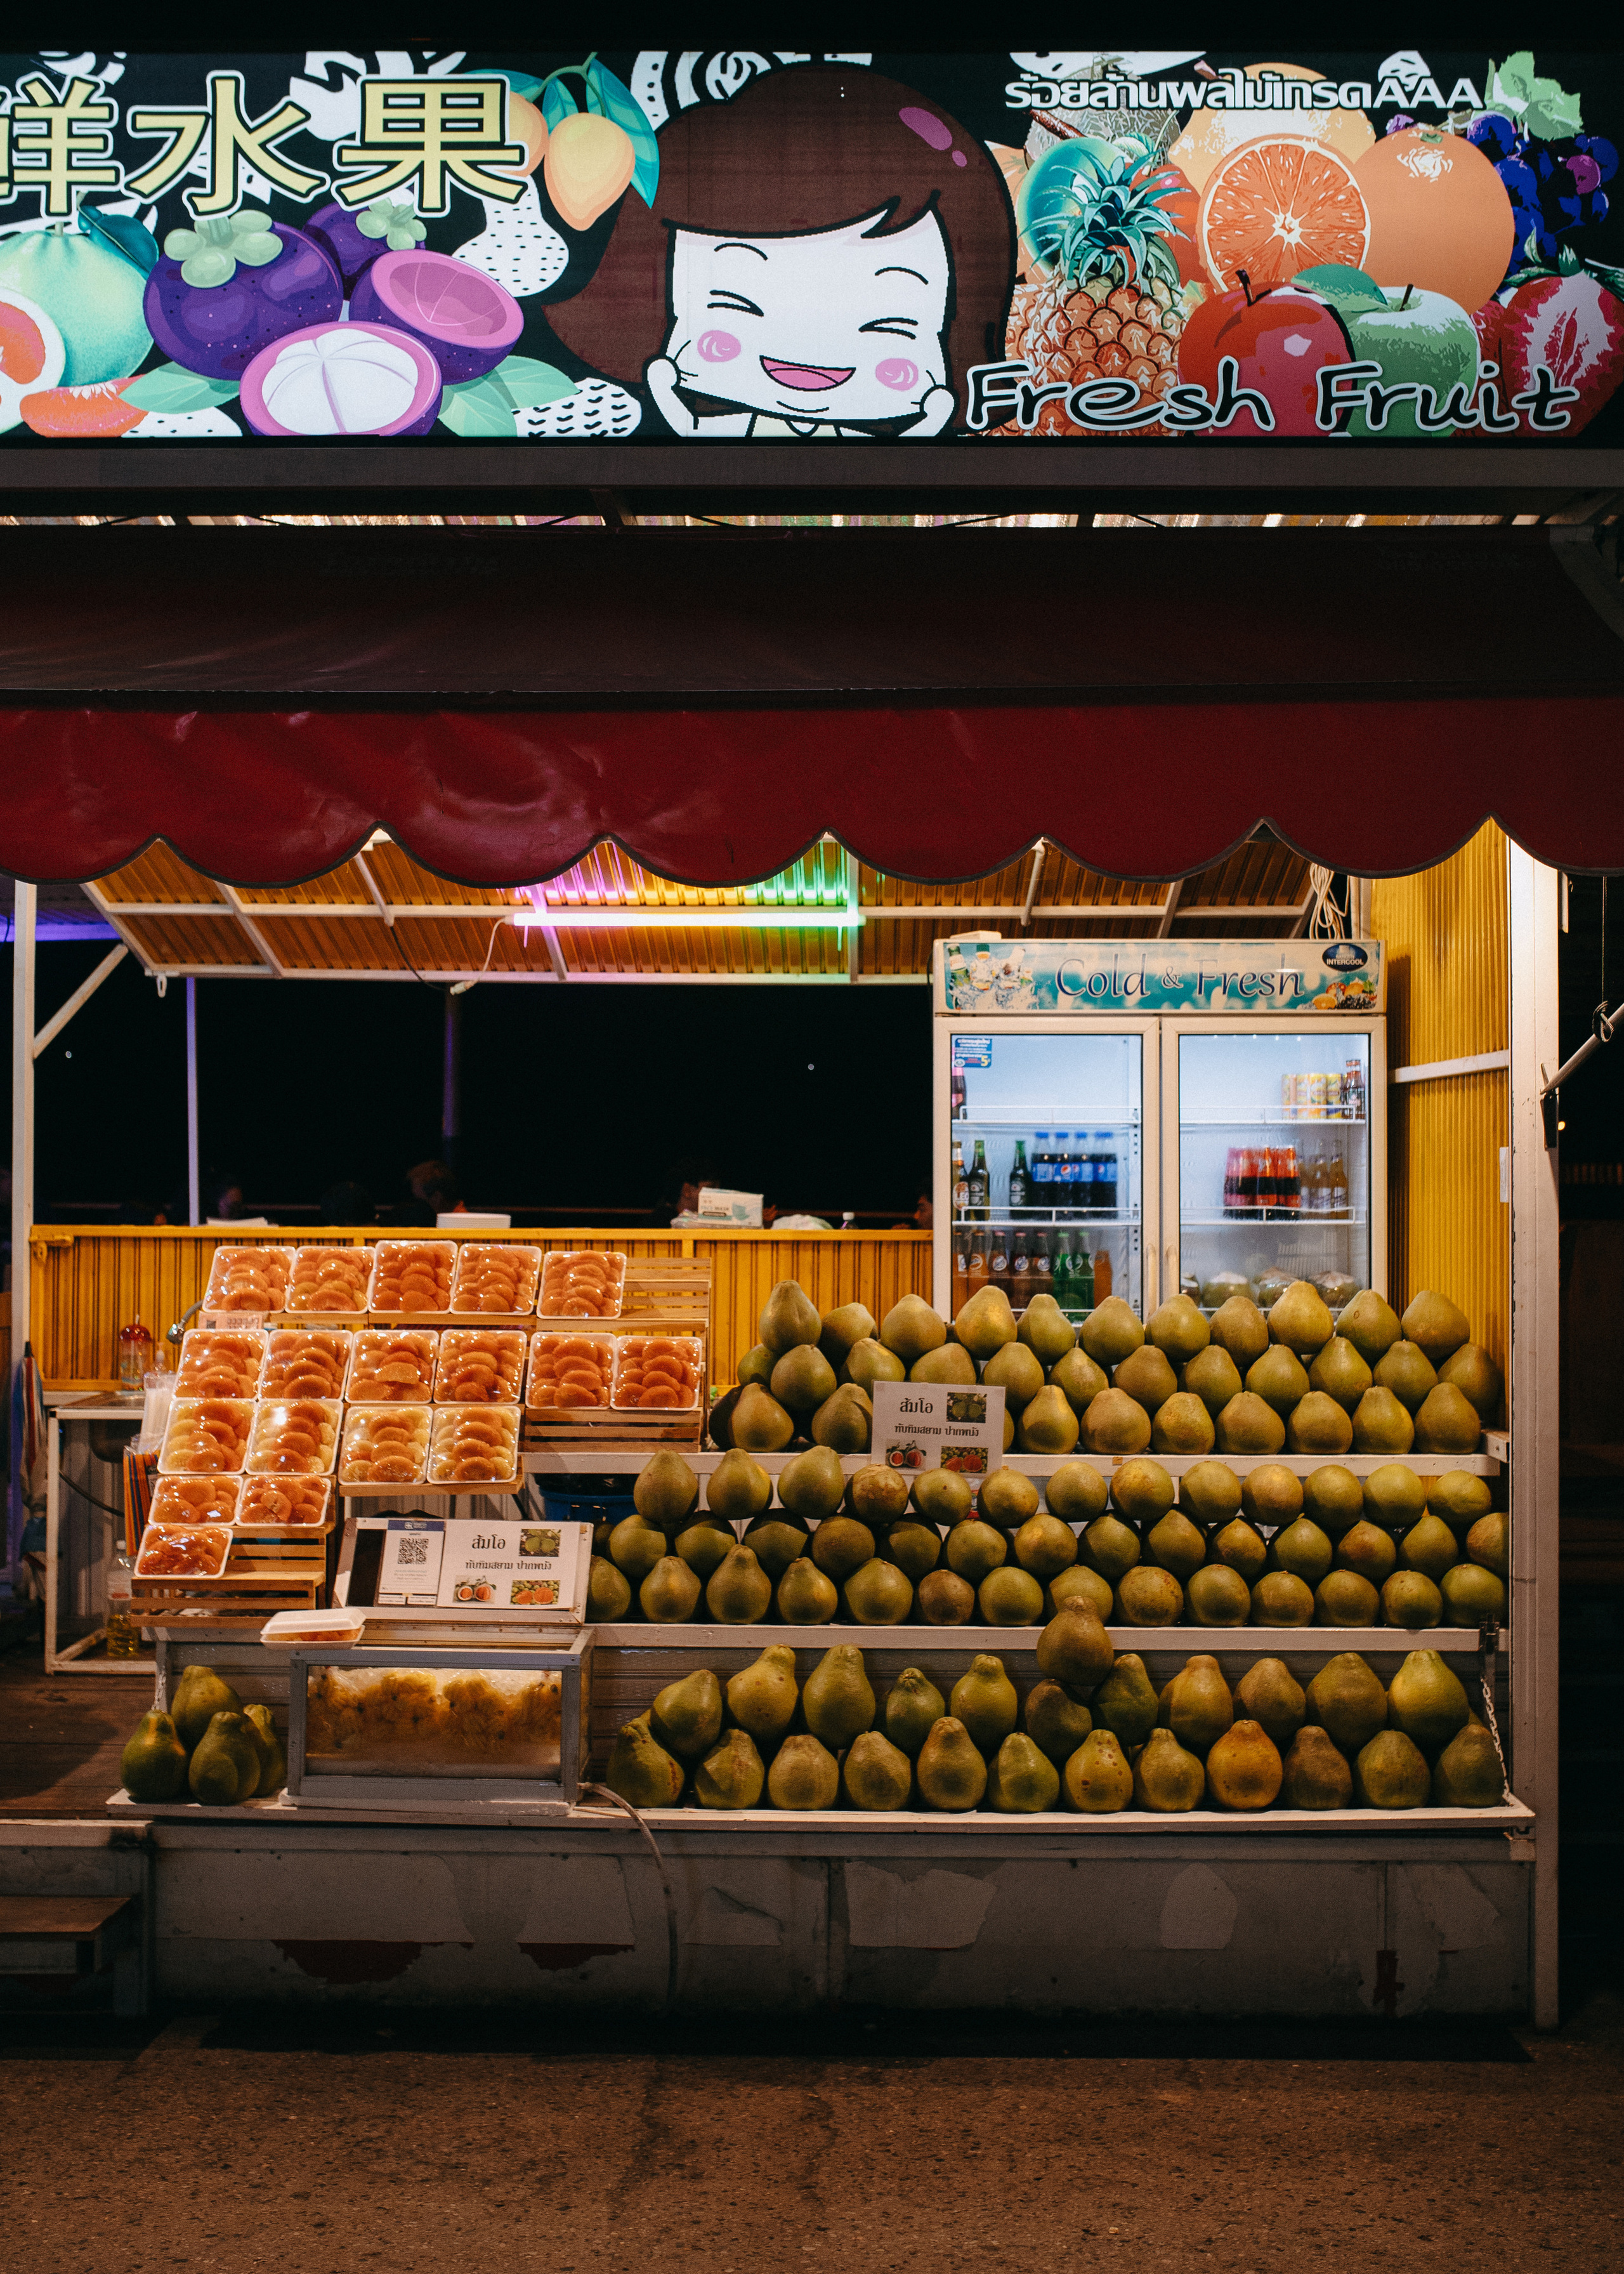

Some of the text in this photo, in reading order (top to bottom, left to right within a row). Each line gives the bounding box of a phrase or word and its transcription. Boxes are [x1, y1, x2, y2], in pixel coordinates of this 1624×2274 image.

[966, 355, 1579, 431] Fresh Fruit
[1056, 952, 1305, 997] Cold & Fresh
[900, 1398, 933, 1413] ส้มโอ
[471, 1534, 506, 1549] ส้มโอ
